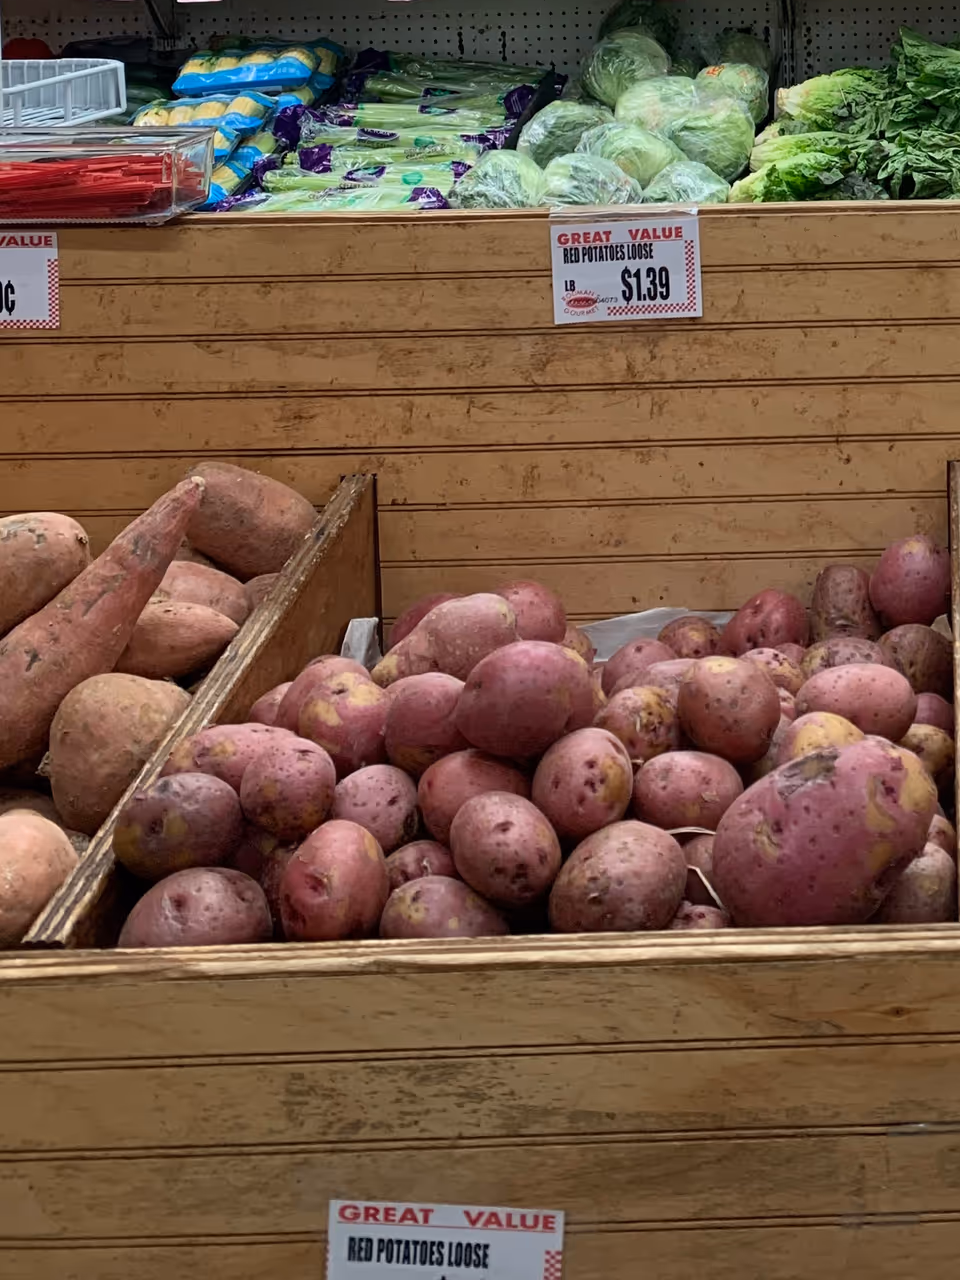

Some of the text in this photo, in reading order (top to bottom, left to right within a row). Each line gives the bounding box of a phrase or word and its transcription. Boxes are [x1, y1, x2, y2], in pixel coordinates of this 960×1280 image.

[557, 226, 683, 245] GREAT VALUE
[563, 243, 654, 264] RED POTATOES LOOSE
[565, 280, 576, 292] LB
[621, 266, 670, 305] $1.39
[563, 305, 600, 317] GOURMET
[338, 1204, 556, 1230] GREAT VALUE
[347, 1236, 490, 1269] RED POTATOES LOOSE
